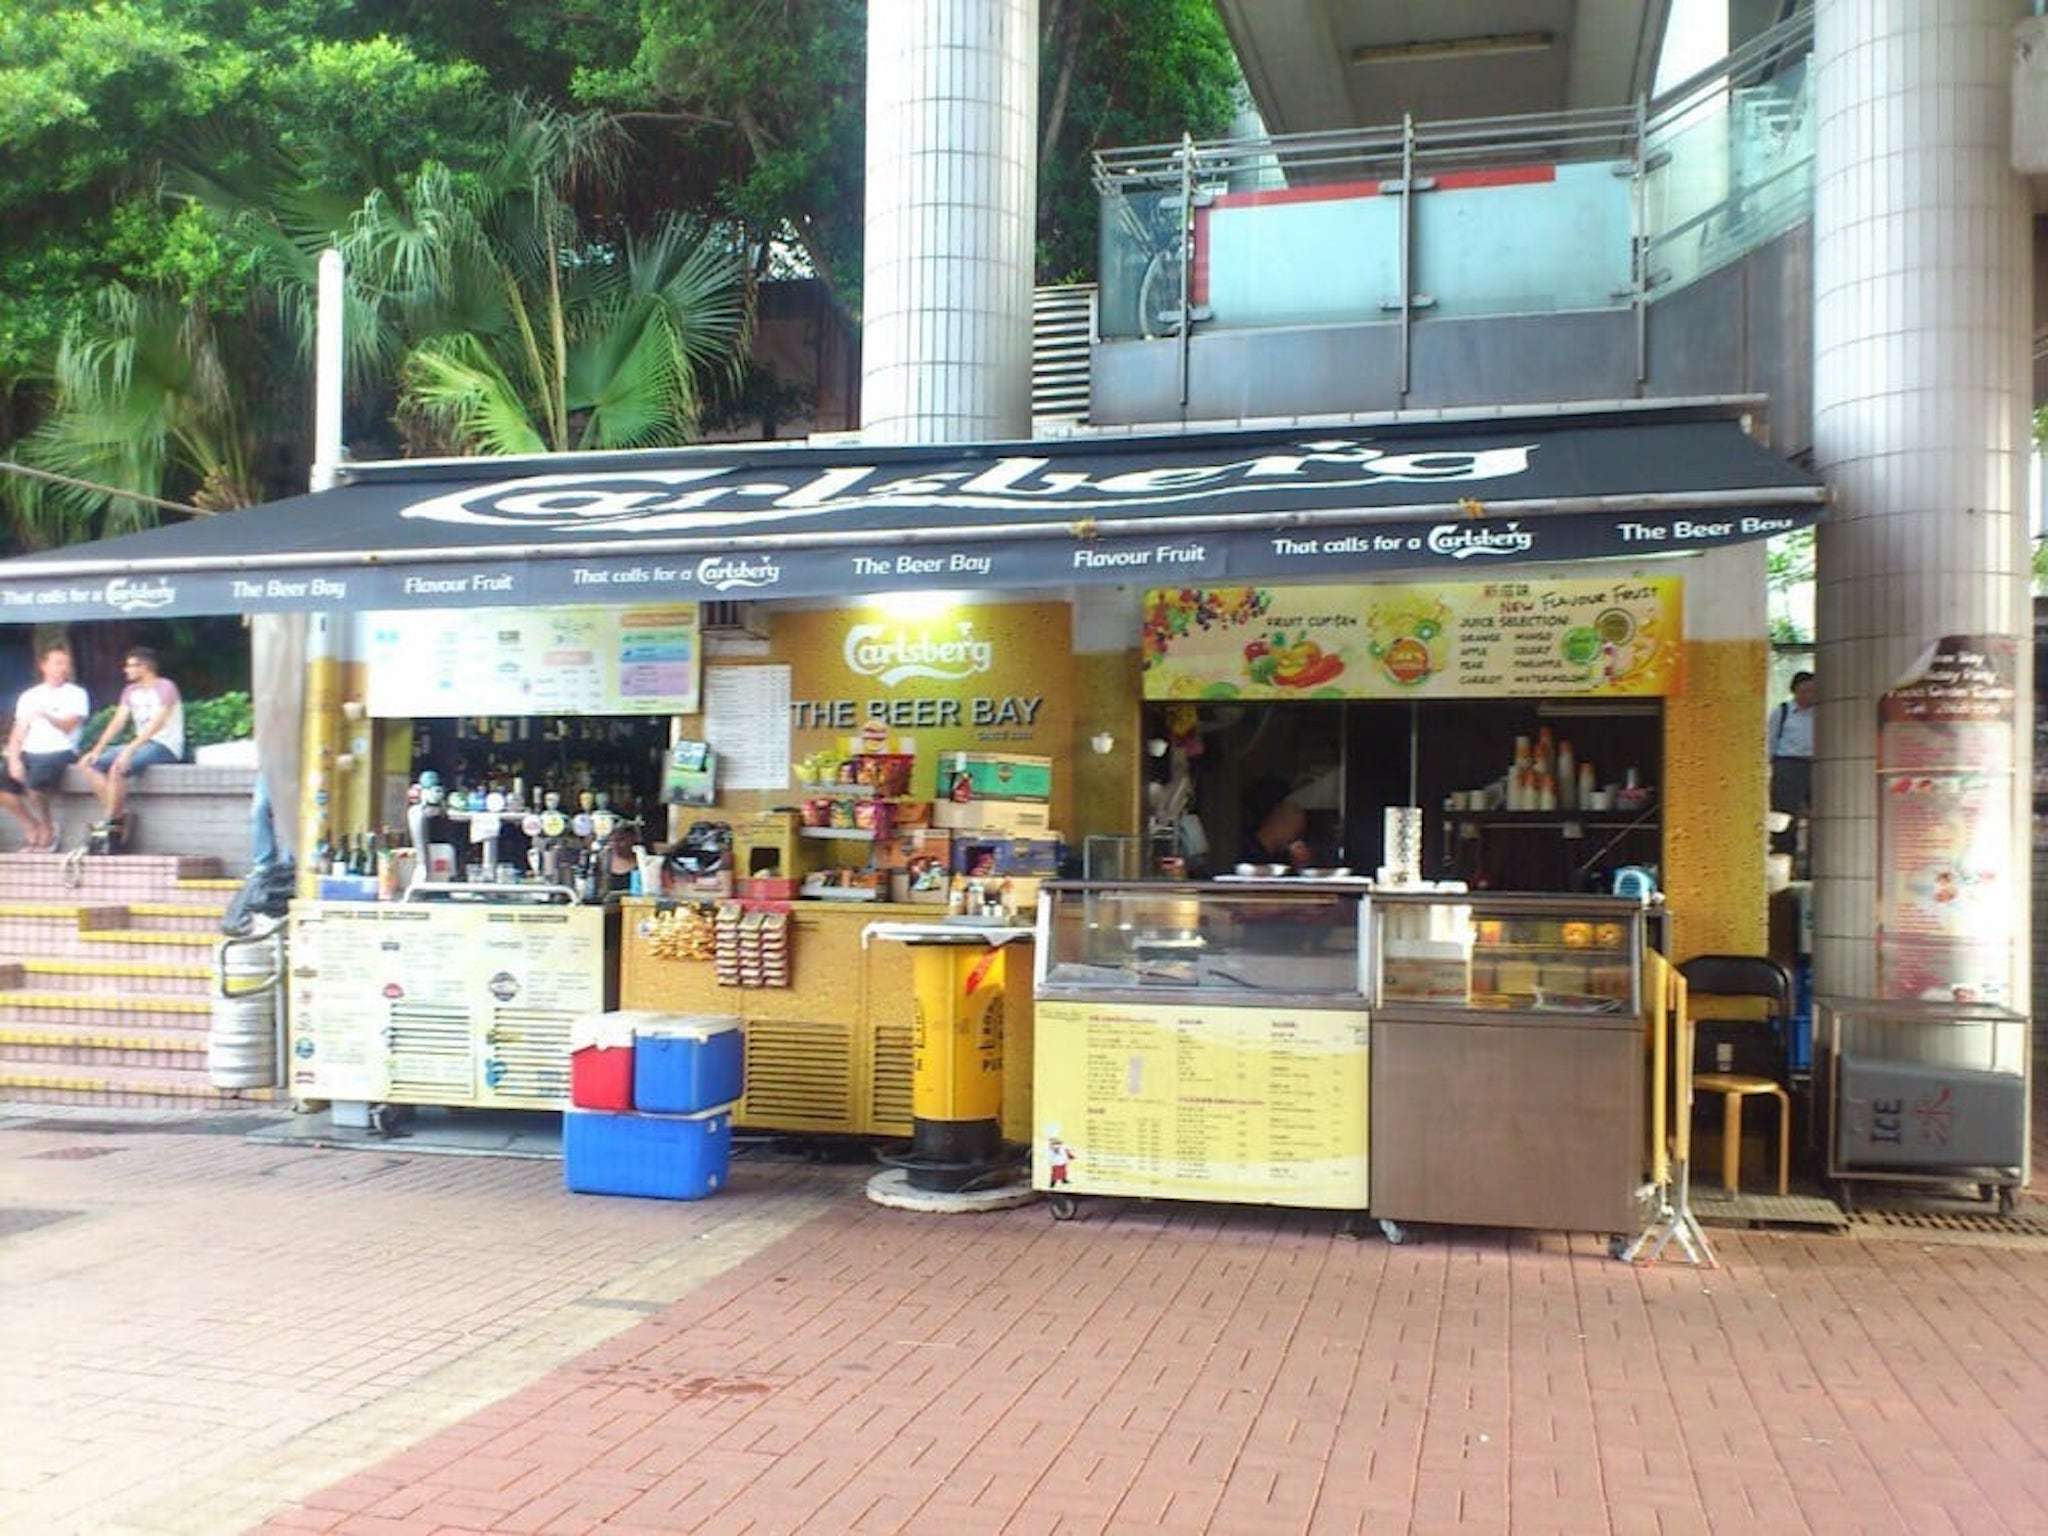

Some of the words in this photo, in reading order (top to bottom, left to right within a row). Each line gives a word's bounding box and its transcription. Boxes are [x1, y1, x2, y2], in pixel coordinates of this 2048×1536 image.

[401, 440, 1539, 532] Carlsberg
[1273, 539, 1318, 555] That
[1323, 536, 1369, 553] calls
[1373, 534, 1402, 551] for
[1407, 538, 1421, 550] a
[1427, 520, 1533, 560] Carlsberg
[1617, 522, 1666, 542] The
[1674, 520, 1733, 539] Beer
[852, 557, 890, 575] The
[896, 556, 944, 574] Beer
[950, 554, 992, 575] Bay
[1074, 550, 1149, 568] Flavour
[1156, 544, 1206, 563] Fruit
[404, 576, 466, 593] Flavour
[472, 572, 513, 591] Fruit
[573, 568, 607, 584] That
[611, 567, 649, 583] calls
[653, 567, 676, 581] for
[679, 569, 691, 580] a
[696, 555, 780, 591] Carlsberg
[3, 590, 33, 604] That
[37, 589, 67, 604] calls
[69, 588, 91, 603] for
[92, 590, 102, 602] a
[105, 577, 176, 611] Carlsberg
[230, 580, 262, 597] The
[266, 579, 306, 597] Beer
[311, 578, 346, 599] Bay
[1460, 617, 1494, 628] JUICE
[1499, 616, 1570, 628] SELECTION
[1501, 601, 1535, 614] NEW
[843, 621, 993, 687] Carlsberg
[791, 700, 858, 729] THE
[867, 697, 963, 728] BEER
[971, 695, 1044, 727] BAY
[1871, 1098, 1901, 1145] ICE
